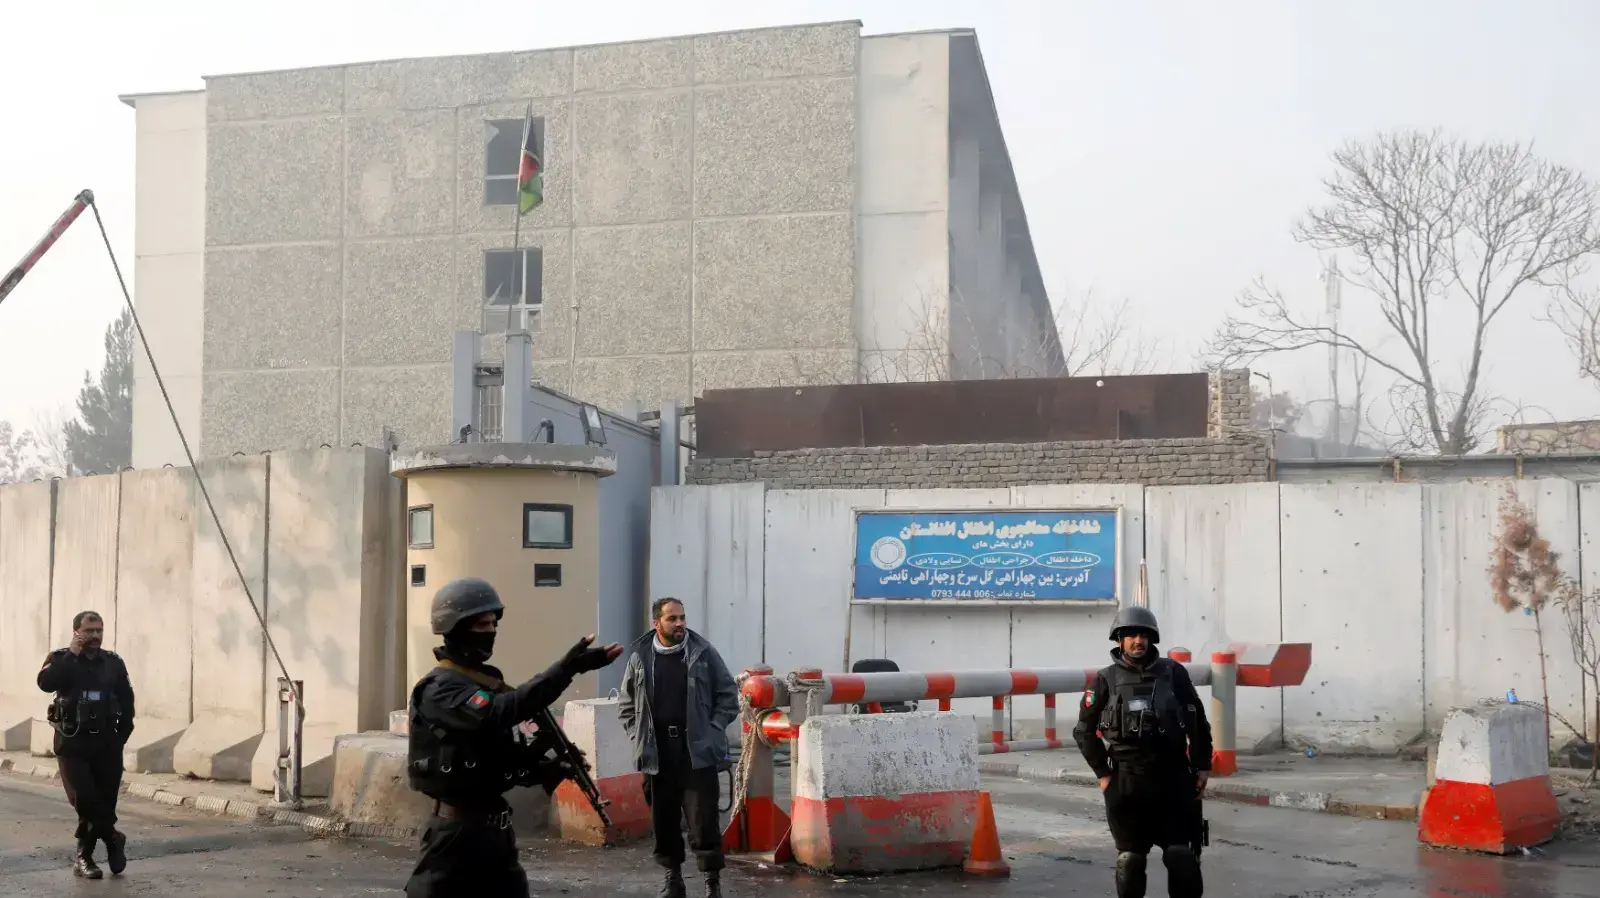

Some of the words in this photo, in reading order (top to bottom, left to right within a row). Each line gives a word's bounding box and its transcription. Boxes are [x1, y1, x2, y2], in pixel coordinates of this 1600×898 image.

[899, 521, 956, 540] افغانستان
[957, 520, 994, 539] اطفال
[972, 540, 988, 549] های
[989, 540, 1010, 549] بخش
[1011, 539, 1034, 549] دارای
[979, 556, 1001, 566] اطفال
[1002, 556, 1029, 565] جراحی
[1046, 556, 1069, 565] اطفال
[956, 570, 978, 586] سرخ
[979, 569, 994, 585] گل
[1038, 572, 1054, 586] بین
[931, 589, 953, 598] 0793
[954, 589, 971, 598] 444
[974, 589, 990, 598] 006
[1015, 589, 1036, 599] شماره
